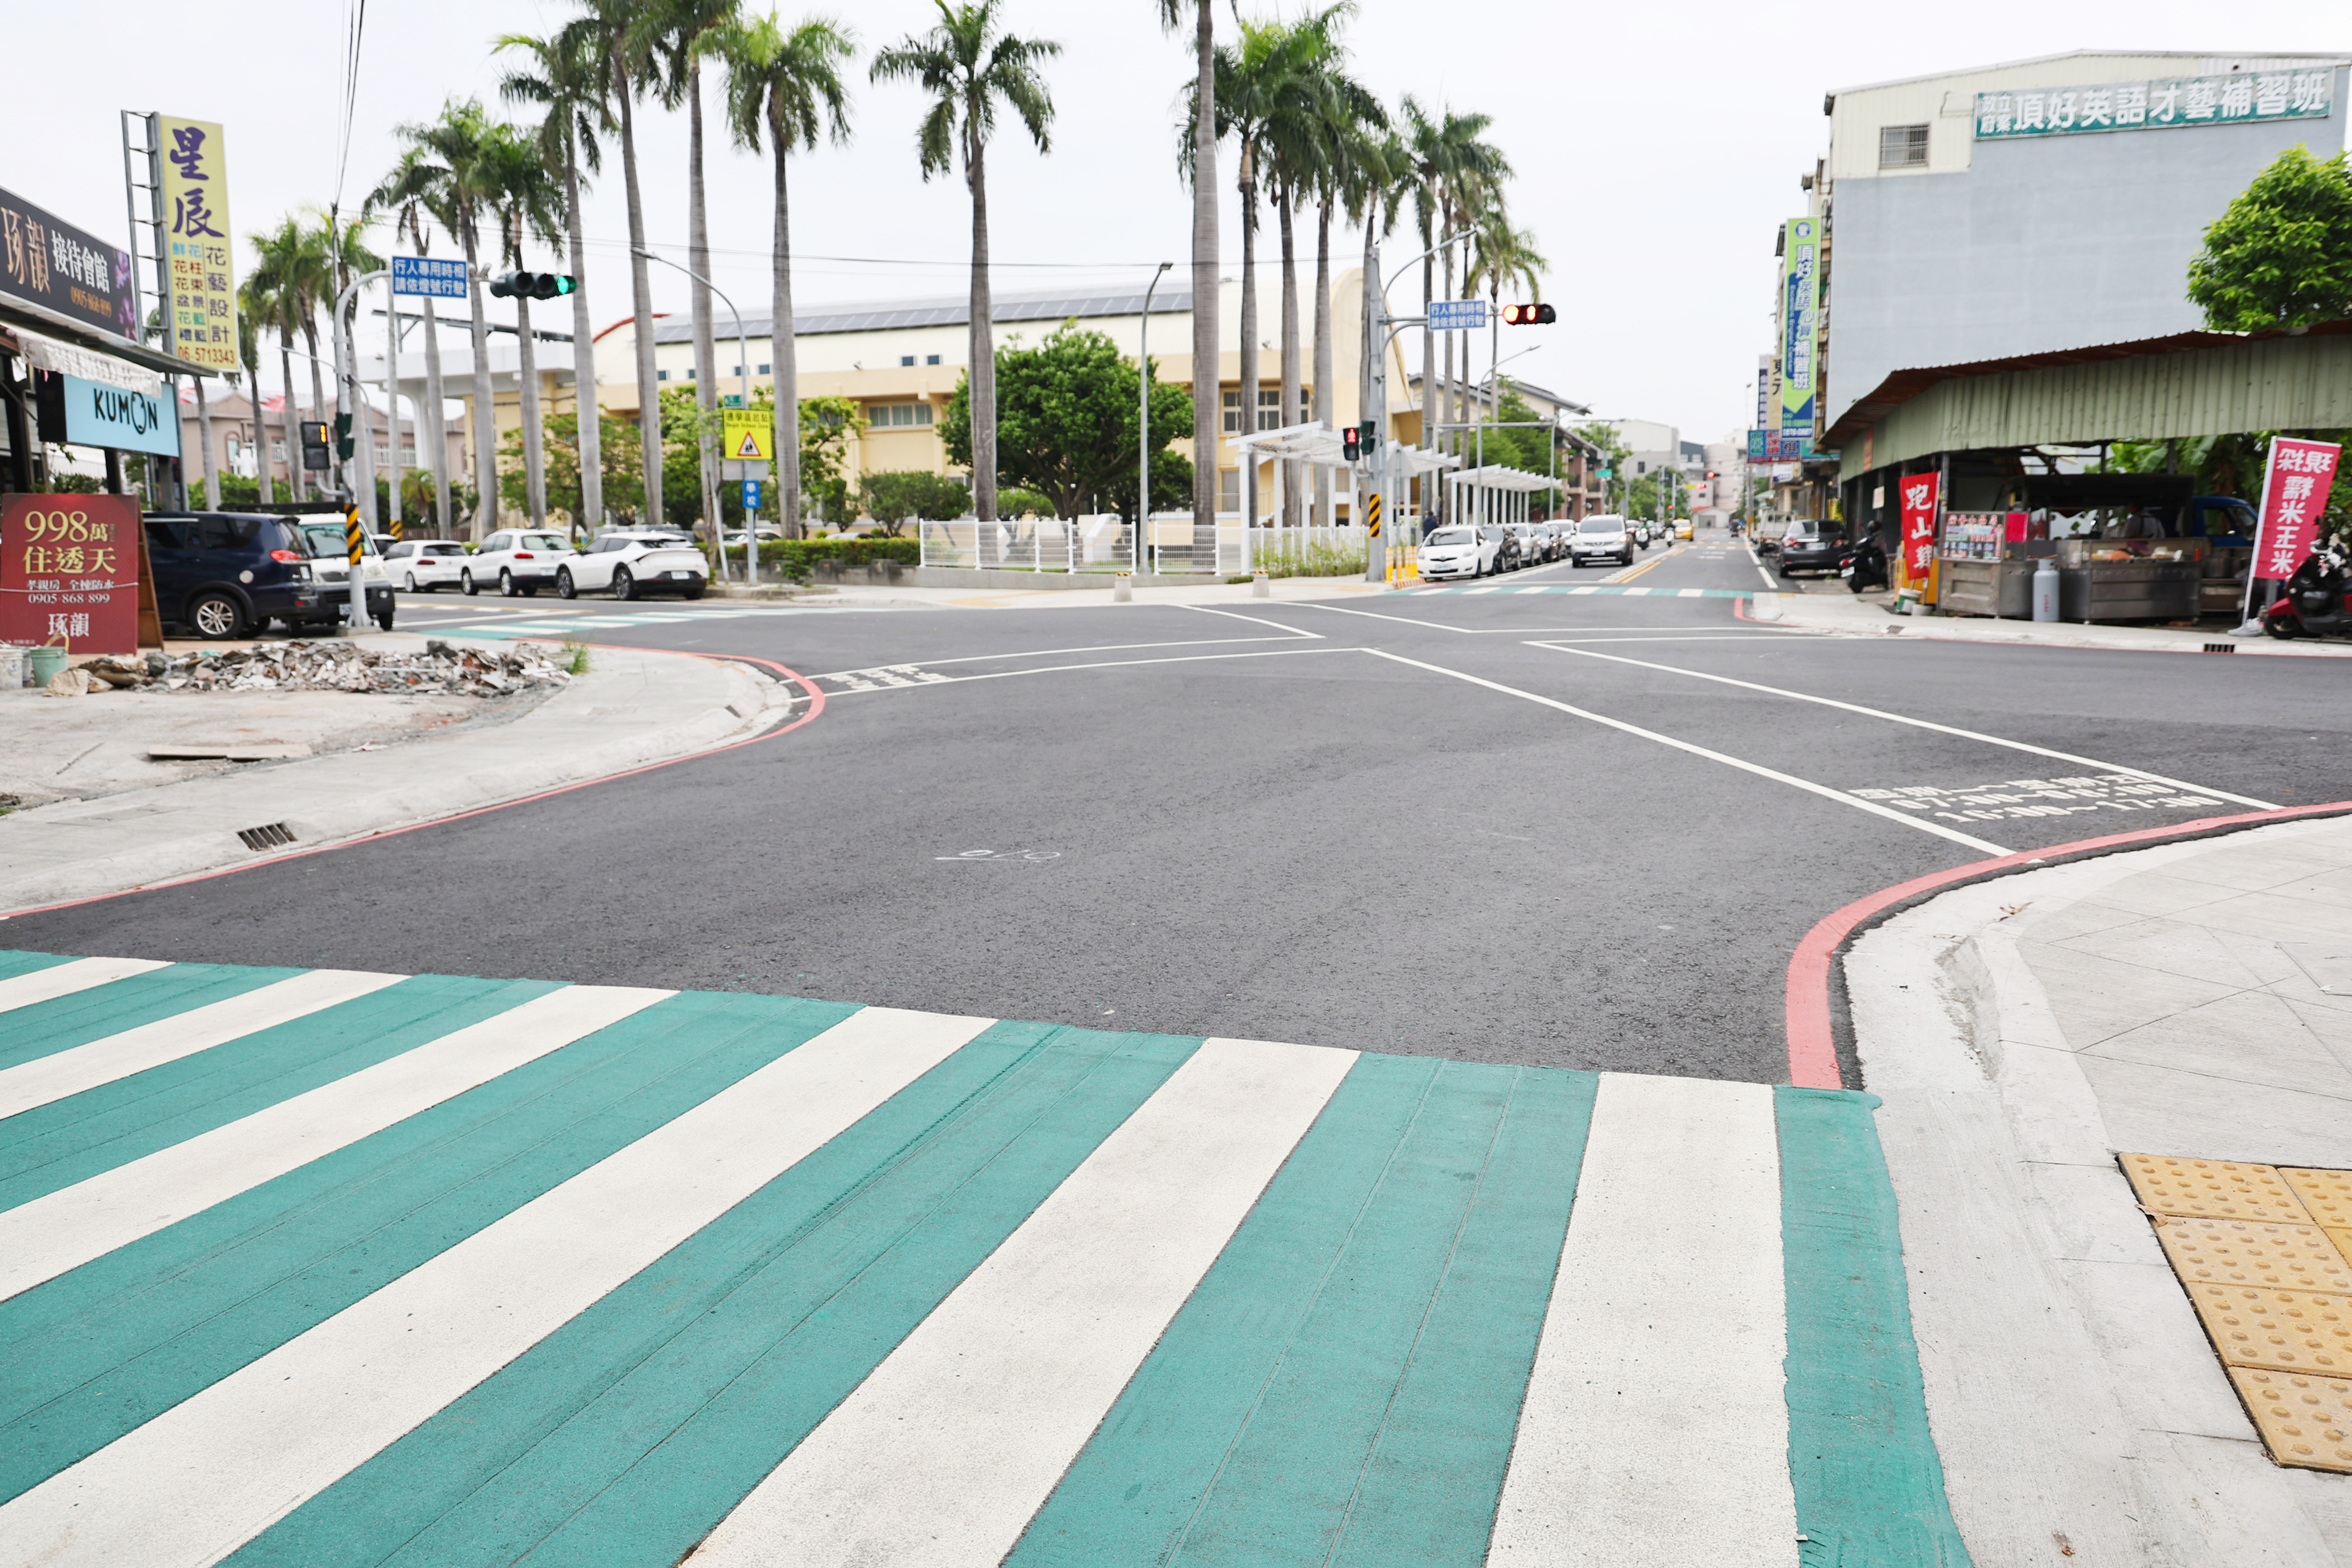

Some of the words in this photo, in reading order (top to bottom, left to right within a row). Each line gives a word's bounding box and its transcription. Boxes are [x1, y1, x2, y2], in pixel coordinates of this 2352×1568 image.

[2013, 72, 2327, 131] 頂好英語才藝補習班
[170, 127, 225, 238] 星辰
[1, 206, 51, 295] 琢韻
[51, 229, 110, 294] 接待會館
[394, 259, 465, 277] 行人專用時相
[206, 246, 230, 344] 花藝設計
[395, 277, 465, 295] 請依燈號行駛
[1430, 315, 1484, 328] 請依燈號行駛
[1431, 302, 1484, 315] 行人專用時相
[177, 346, 235, 364] 06-5713343
[94, 389, 158, 435] KUMON
[746, 482, 757, 506] 學校
[25, 510, 109, 542] 998萬
[1905, 484, 1933, 569] 跑山雞
[22, 546, 116, 574] 住透天
[28, 593, 111, 604] 0905-868-899
[47, 612, 90, 637] 琢韻
[1889, 783, 2177, 809] 07:00~08:00
[1934, 795, 2225, 823] 16:00~17:00
